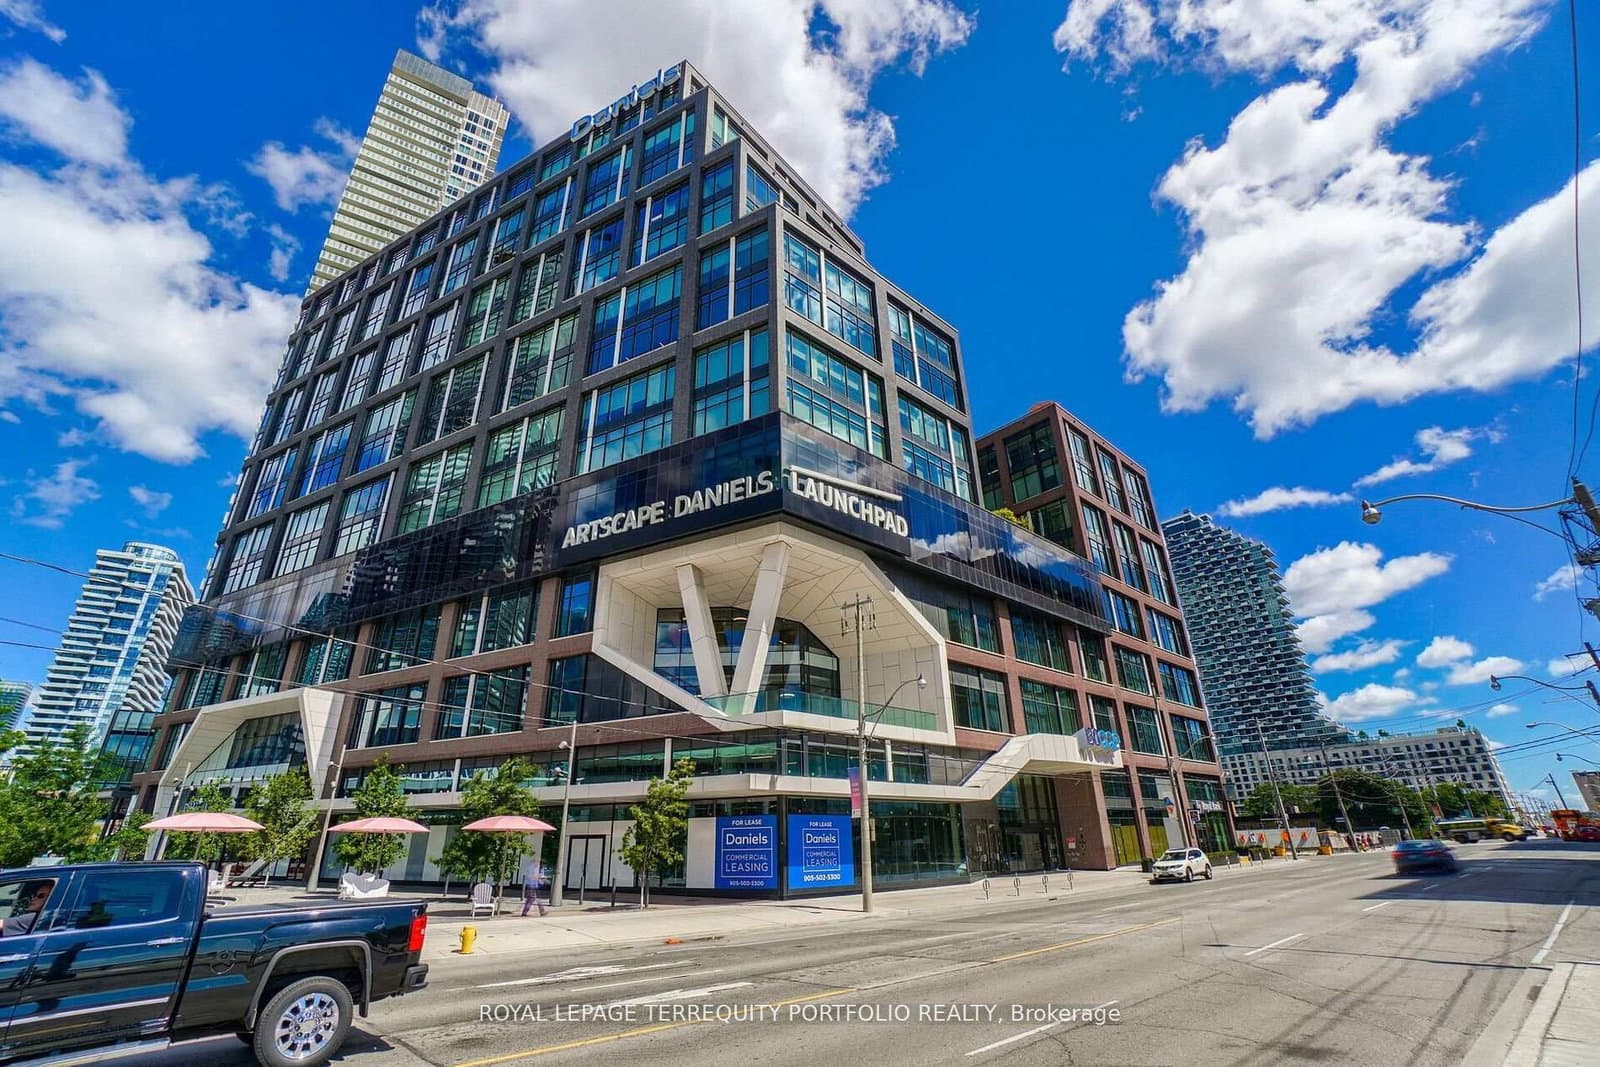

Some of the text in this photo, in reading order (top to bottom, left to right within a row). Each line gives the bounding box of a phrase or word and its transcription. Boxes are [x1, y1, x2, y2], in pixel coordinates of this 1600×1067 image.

[570, 63, 681, 143] Daniels
[561, 470, 773, 549] ARTSCAPE DANIELS
[791, 470, 909, 537] LAUNCHPAD
[726, 832, 768, 845] Daniels
[806, 833, 837, 844] Daniels
[725, 862, 769, 872] LEASING
[806, 858, 837, 867] LEASING
